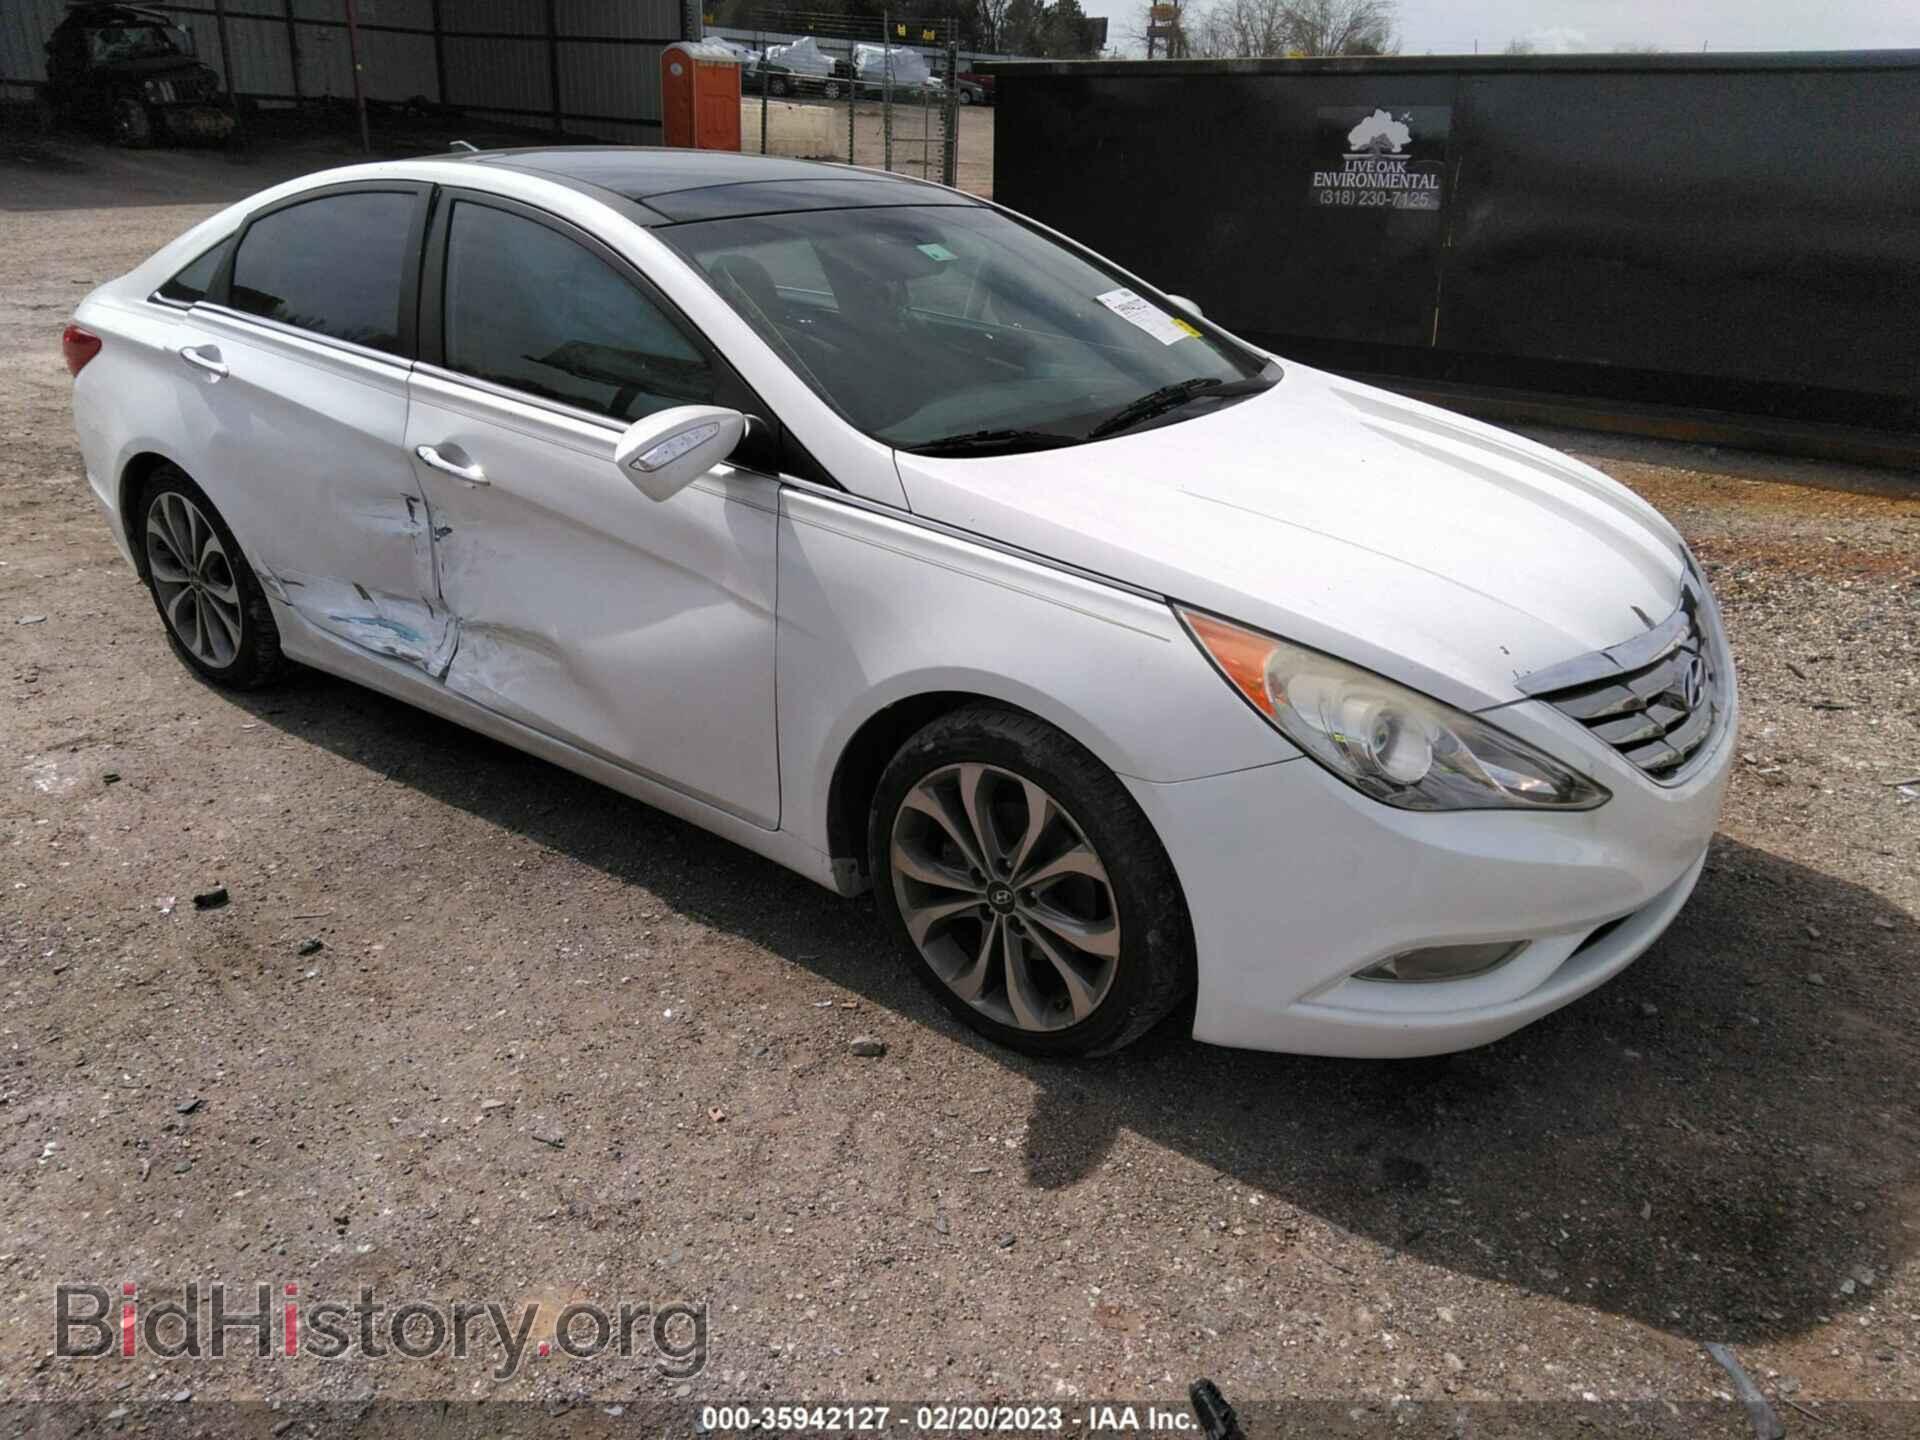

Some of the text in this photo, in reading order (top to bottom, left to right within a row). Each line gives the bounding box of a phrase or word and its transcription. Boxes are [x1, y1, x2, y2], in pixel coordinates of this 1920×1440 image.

[1344, 160, 1407, 174] LIVE OAK
[1313, 172, 1440, 189] ENVIRONMENTAL
[1320, 190, 1356, 206] (318)
